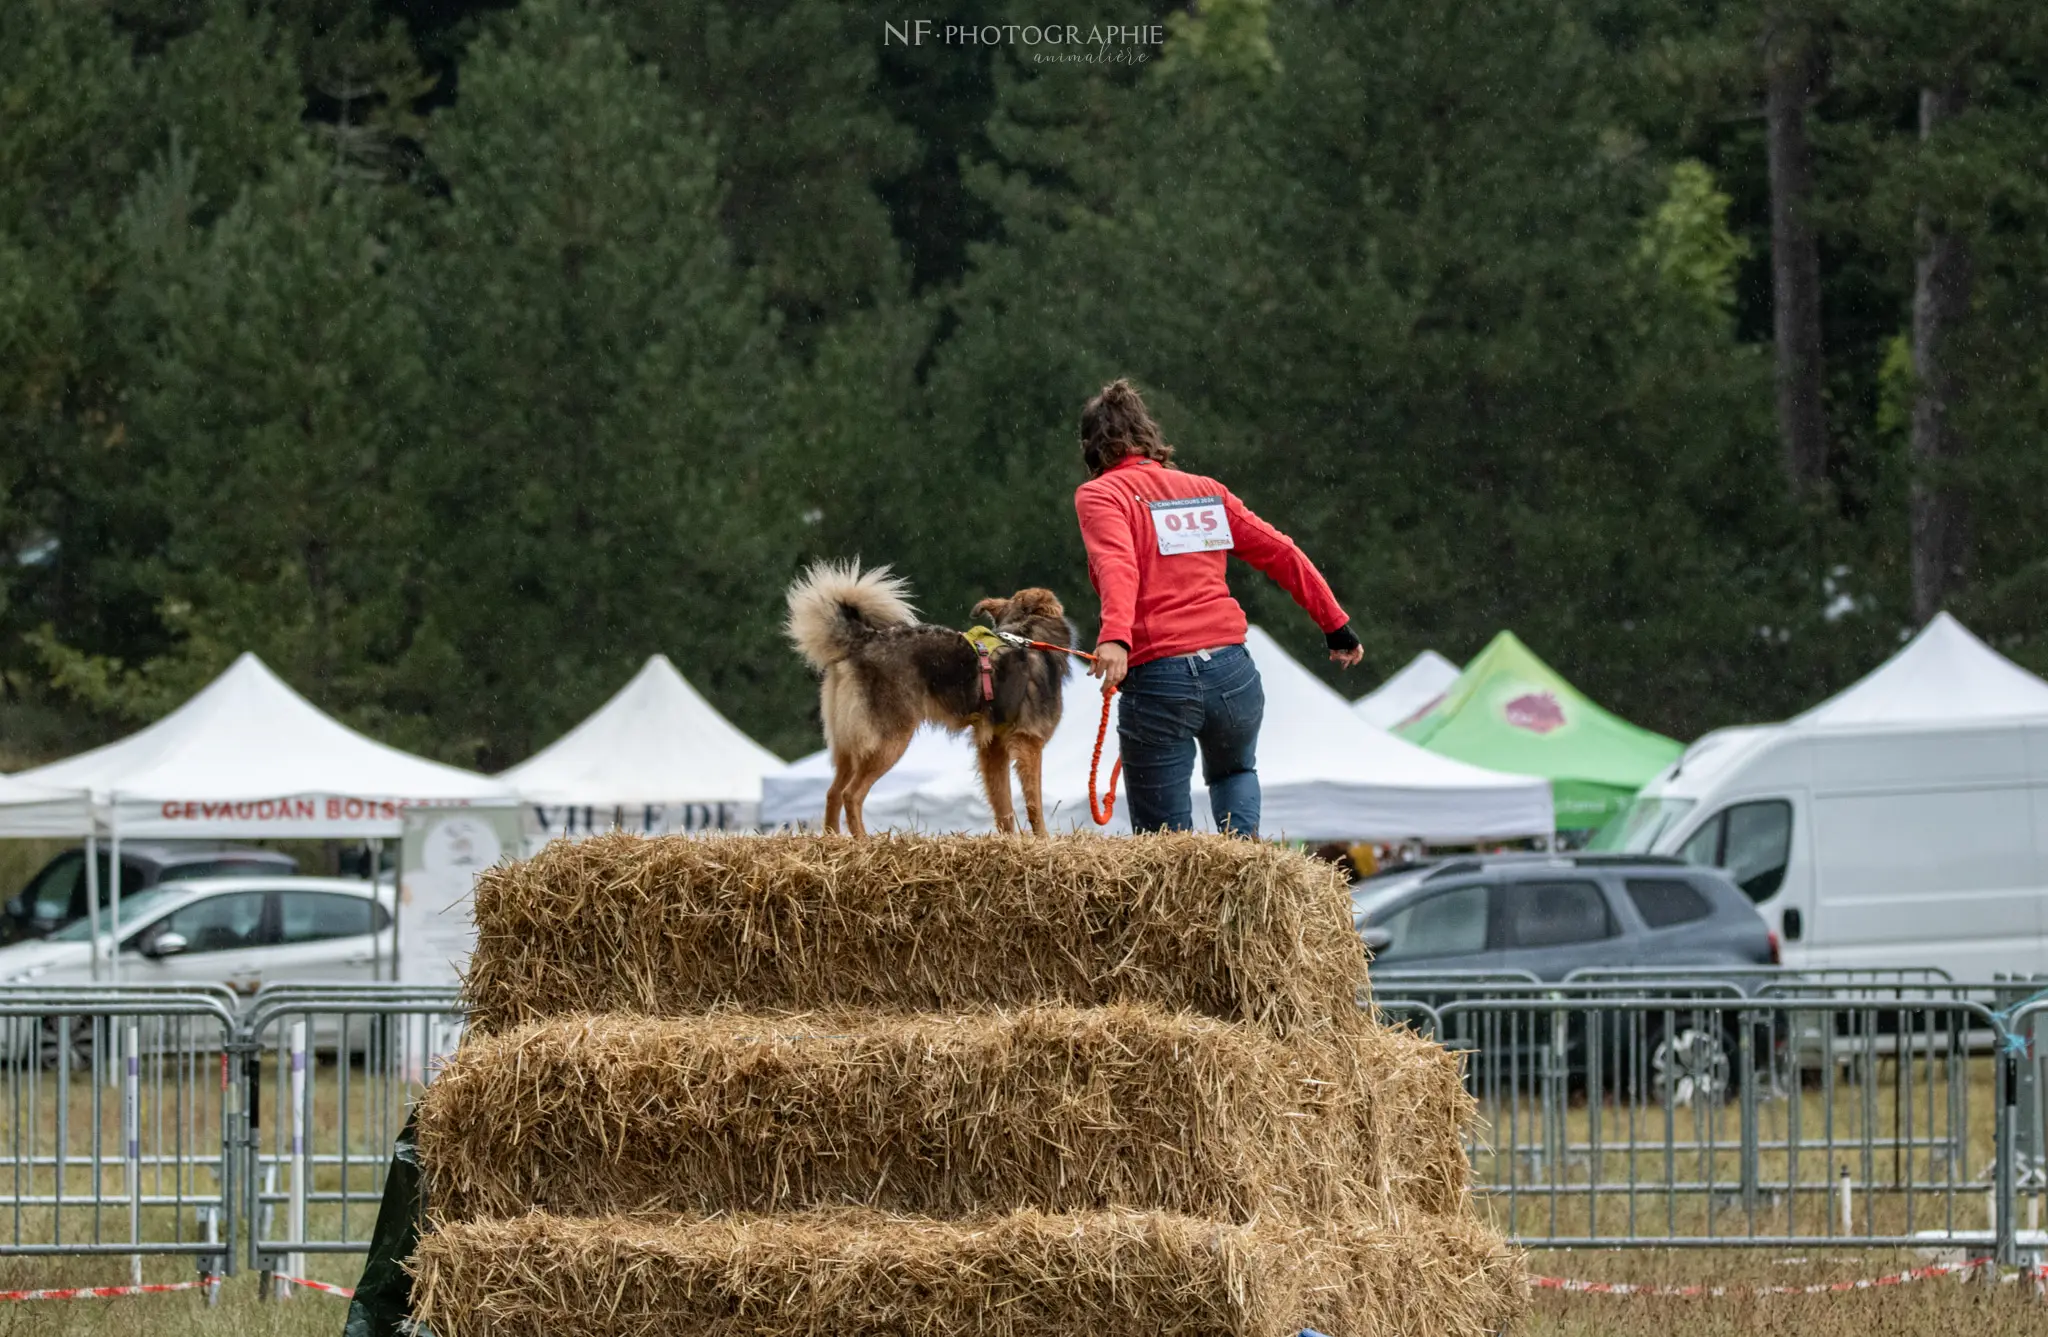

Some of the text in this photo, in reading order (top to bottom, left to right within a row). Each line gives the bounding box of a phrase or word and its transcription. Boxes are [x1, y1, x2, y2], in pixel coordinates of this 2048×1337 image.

[1165, 510, 1218, 532] 015
[161, 799, 314, 821] GEVAUDAN
[684, 802, 736, 832] DE
